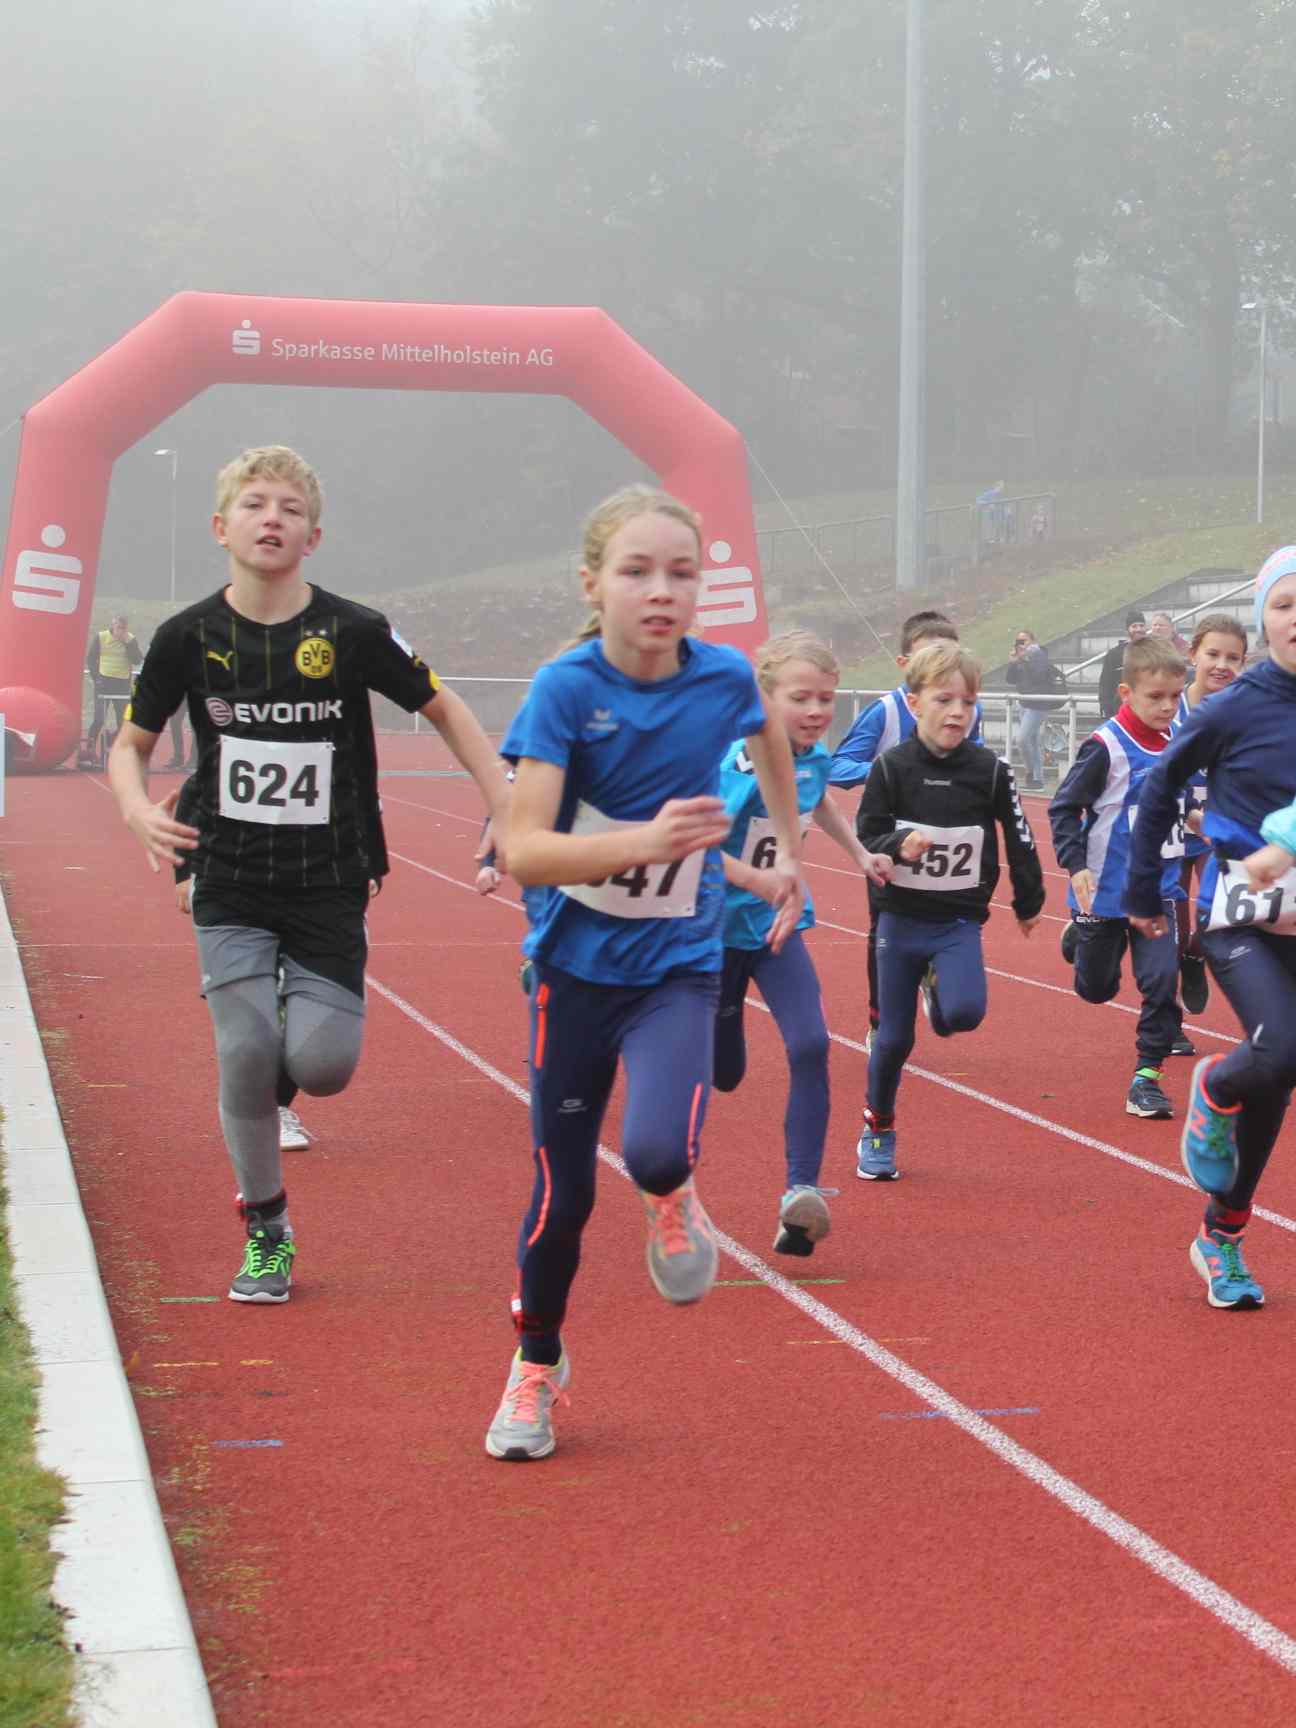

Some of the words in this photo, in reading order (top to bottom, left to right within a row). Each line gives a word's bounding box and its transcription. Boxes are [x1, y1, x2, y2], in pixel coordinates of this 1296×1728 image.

[271, 337, 376, 361] Sparkasse
[381, 343, 521, 366] Mittelholstein
[525, 348, 554, 367] AG
[233, 699, 344, 724] EVONIK
[228, 759, 320, 808] 624
[586, 857, 685, 898] 47
